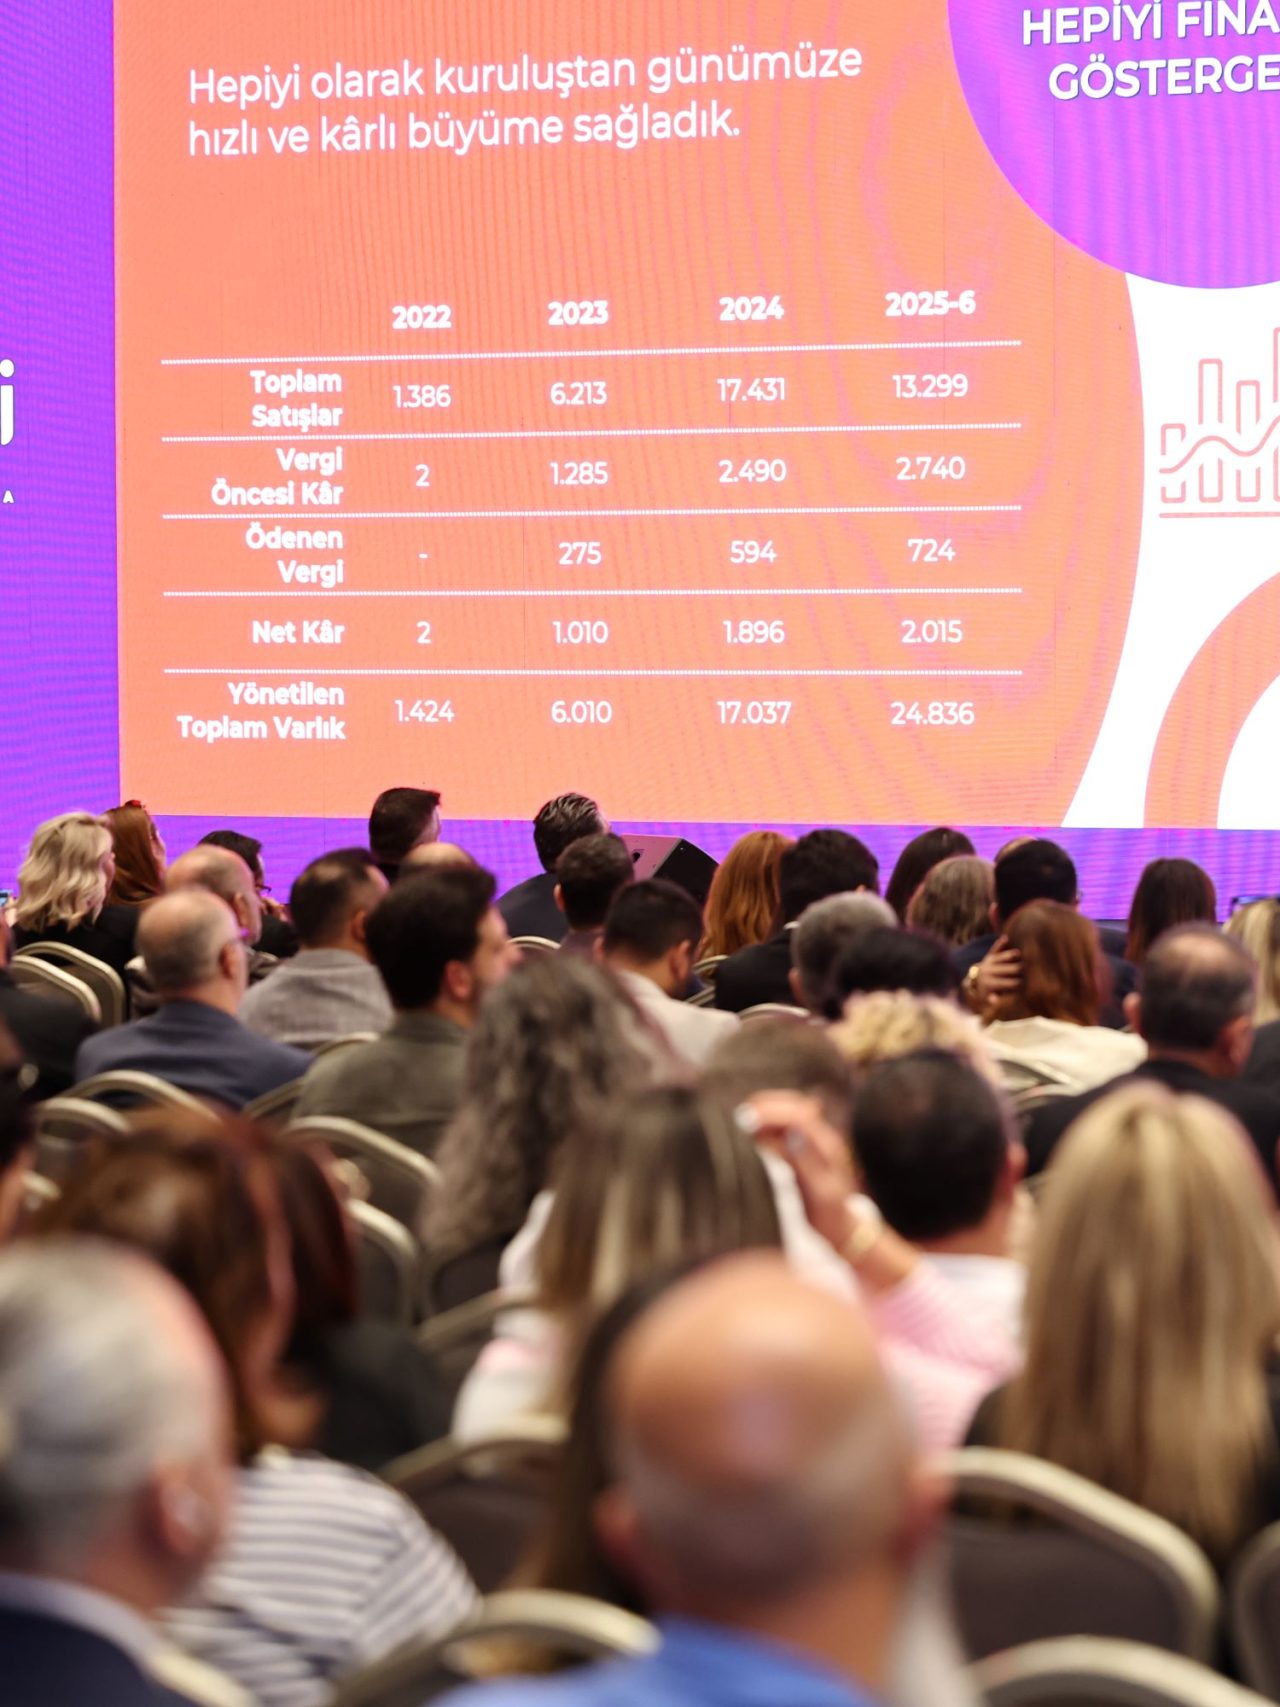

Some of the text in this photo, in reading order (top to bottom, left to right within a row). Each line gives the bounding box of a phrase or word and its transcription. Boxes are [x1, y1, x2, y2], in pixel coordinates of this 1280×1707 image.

[1022, 0, 1163, 46] HEPİYİ
[189, 41, 863, 111] Hepiyi olarak kuruluştan günümüze
[188, 98, 740, 156] hızlı ve kârlı büyüme sağladık.
[391, 289, 977, 330] 2022 2023 2024 2025-6
[249, 367, 342, 399] Toplam
[393, 373, 969, 409] 1.386 6.213 17.431 13.299
[250, 402, 343, 433] Satışlar
[275, 446, 343, 477] Vergi
[414, 455, 966, 488] 2 1.285 2.490 2.740
[210, 477, 344, 506] Öncesi Kâr
[244, 521, 344, 550] Ödenen
[557, 541, 602, 566] 275
[729, 540, 778, 565] 594
[906, 537, 957, 562] 724
[277, 558, 344, 589] Vergi
[251, 619, 963, 645] Net Kâr 2 1.010 1.896 2.015
[226, 679, 345, 707] Yönetilen
[394, 699, 976, 726] 1.424 6.010 17.037 24.836
[176, 714, 346, 744] Toplam Varlık
